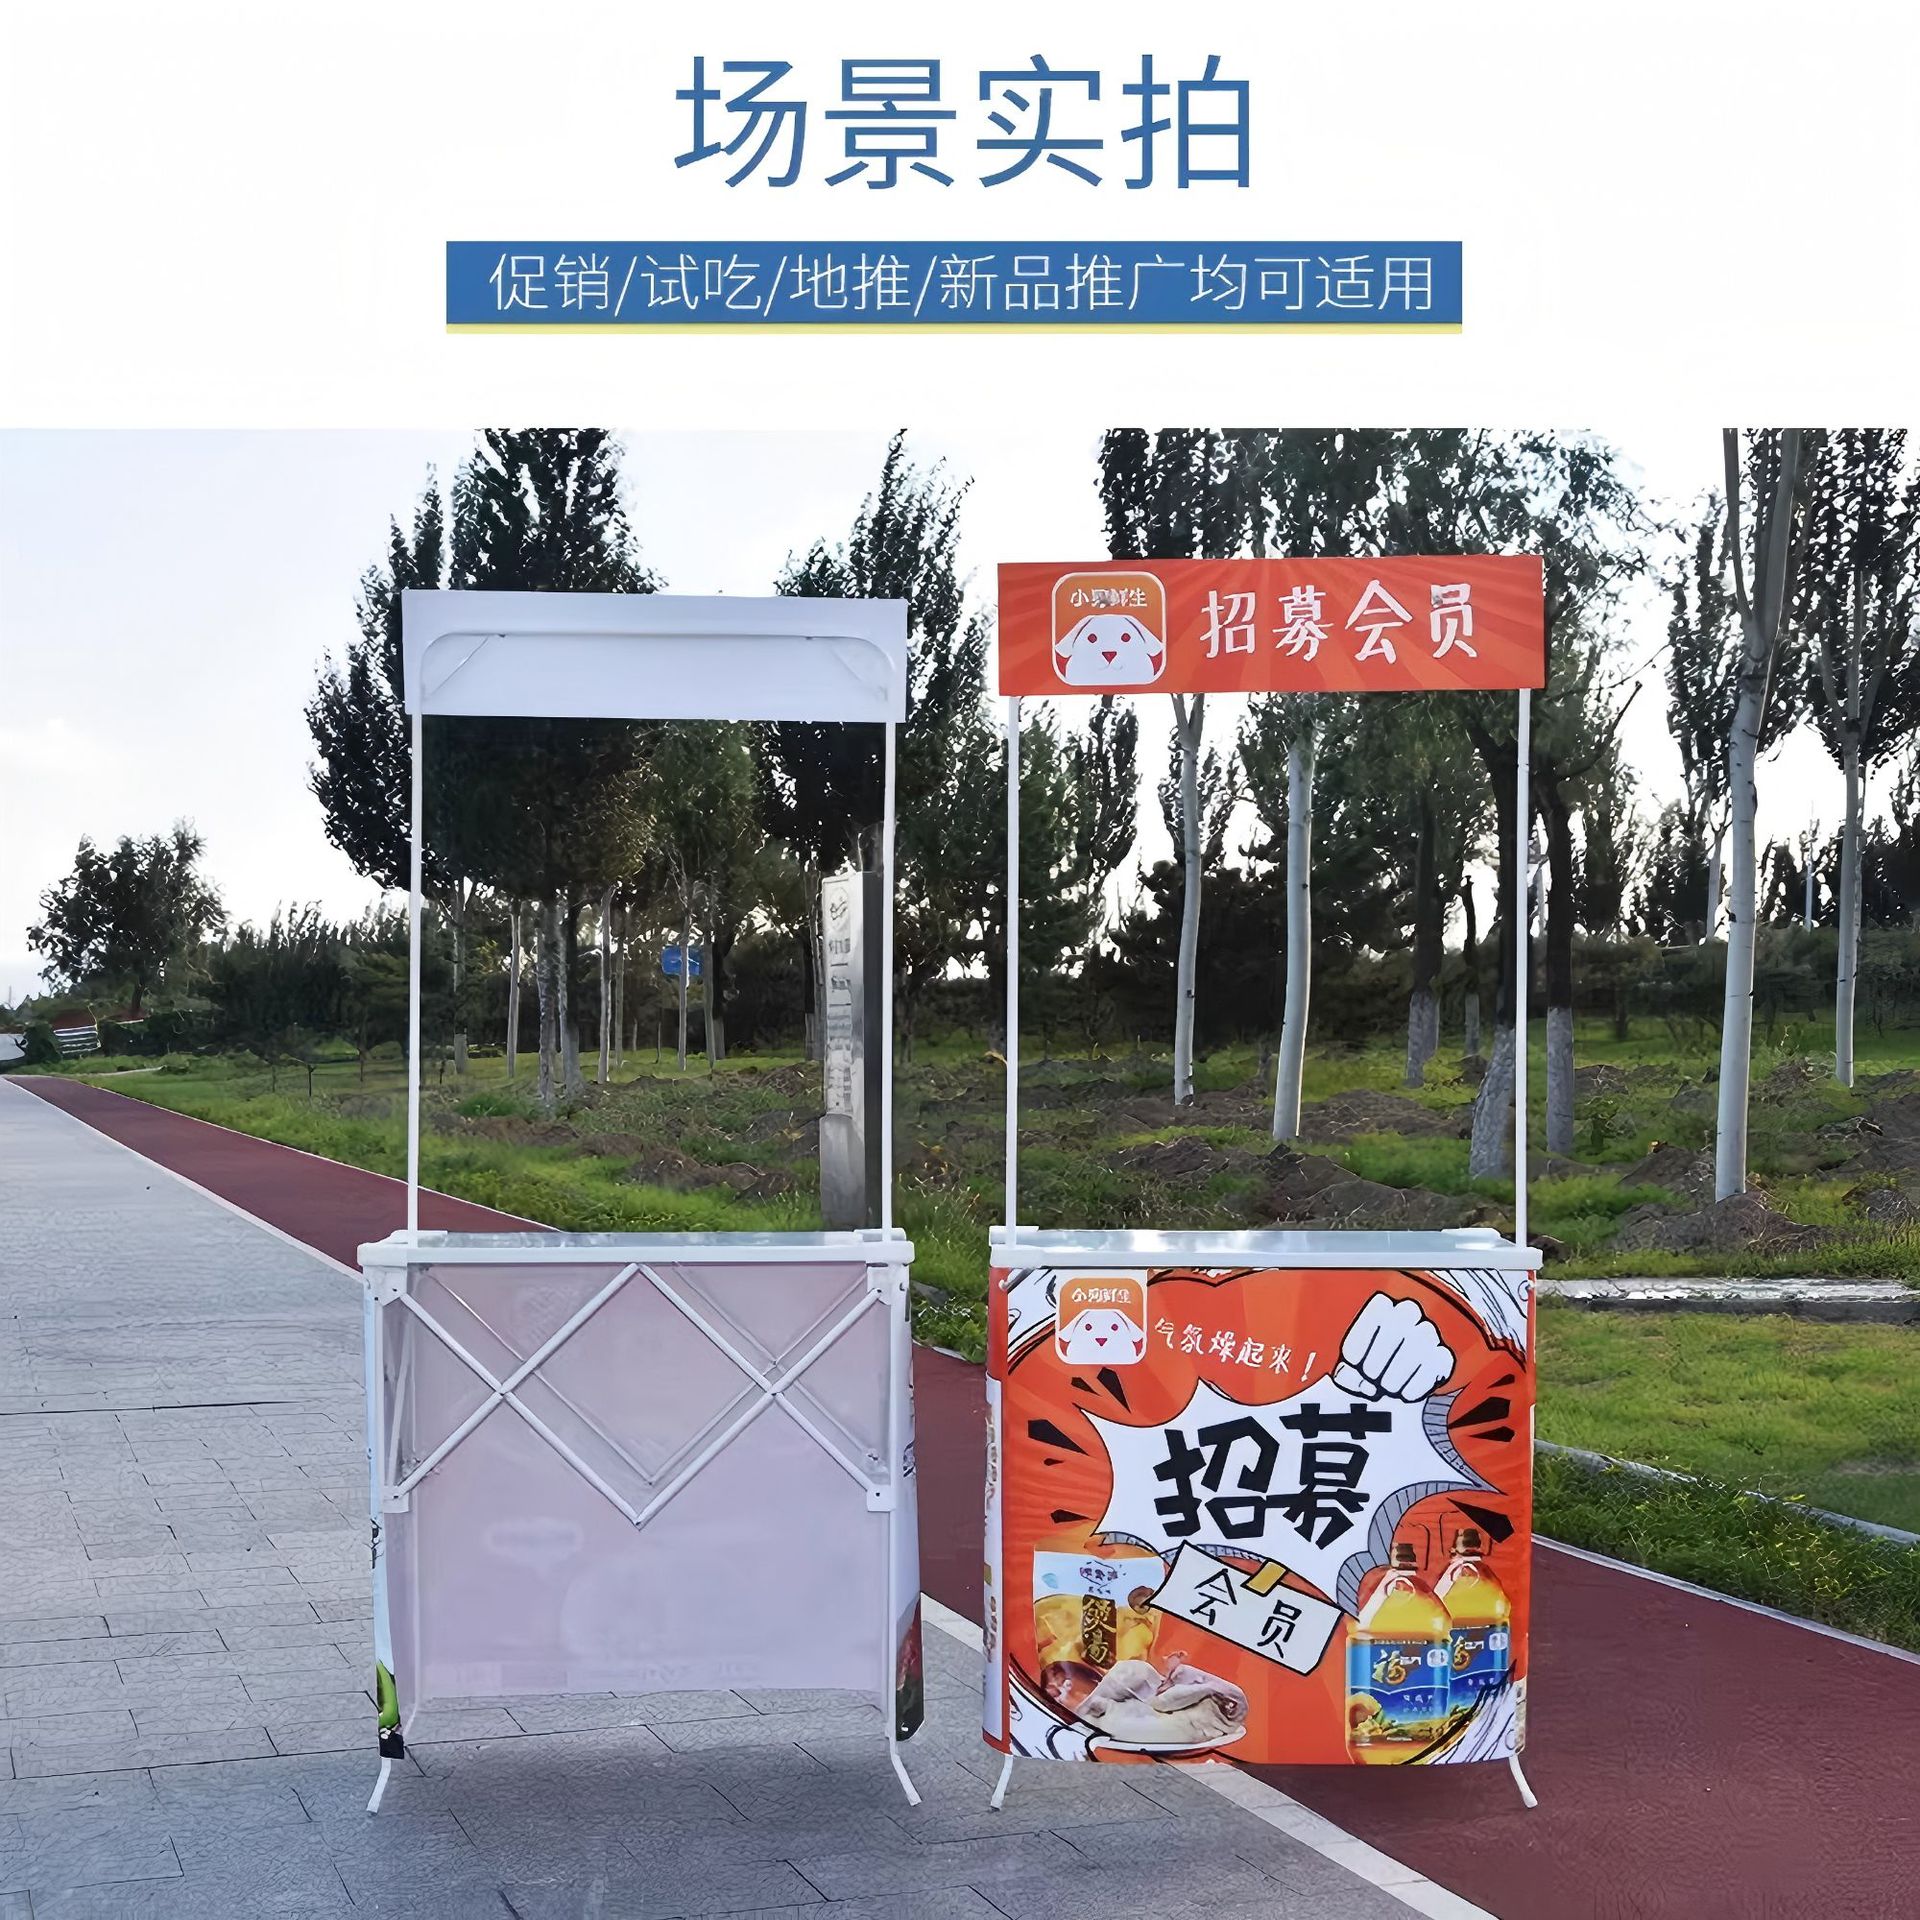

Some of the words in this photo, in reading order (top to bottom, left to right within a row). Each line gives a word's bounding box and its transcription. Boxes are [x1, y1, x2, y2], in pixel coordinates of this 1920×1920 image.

[1200, 579, 1478, 664] 招募会员
[1153, 1403, 1392, 1550] 招募
[1190, 1568, 1302, 1658] 会员
